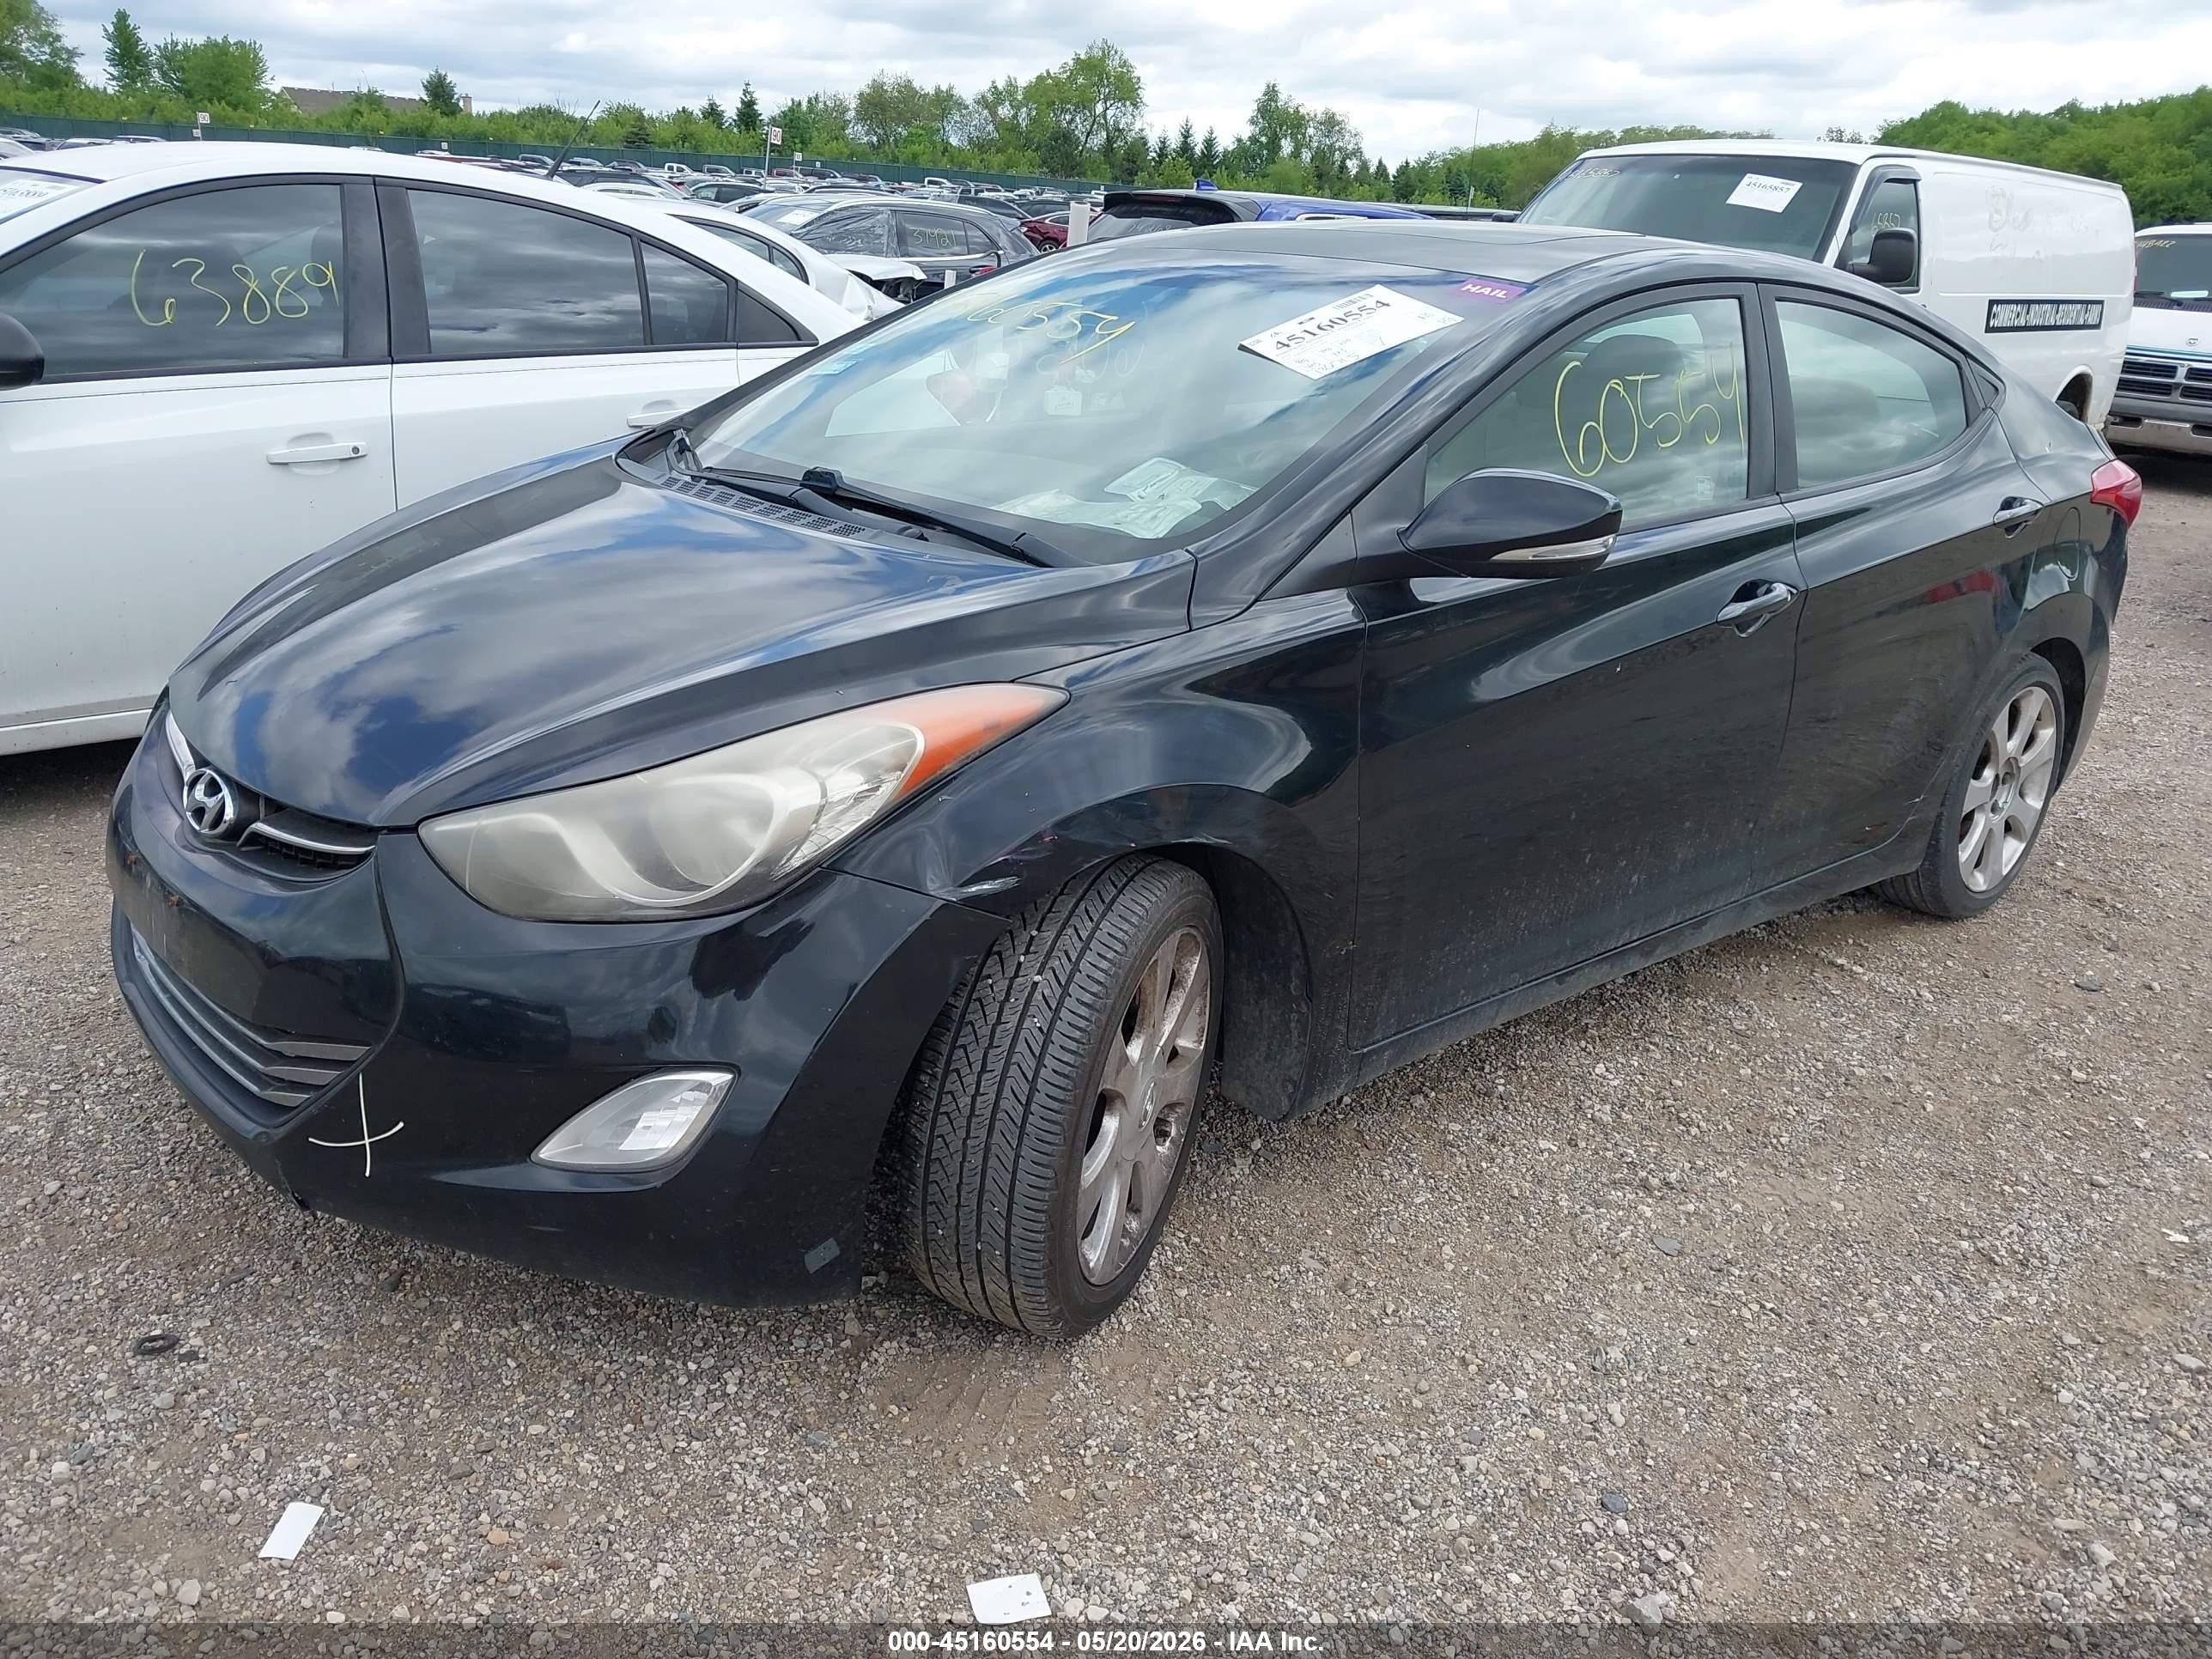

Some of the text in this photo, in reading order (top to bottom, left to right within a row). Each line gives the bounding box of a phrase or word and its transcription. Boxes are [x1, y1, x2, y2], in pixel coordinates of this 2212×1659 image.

[772, 130, 781, 142] 90
[1746, 180, 1791, 194] 45165857
[130, 247, 340, 327] 63889
[1461, 283, 1508, 299] HAIL
[1274, 299, 1392, 351] 45160554
[1553, 342, 1745, 477] 60554
